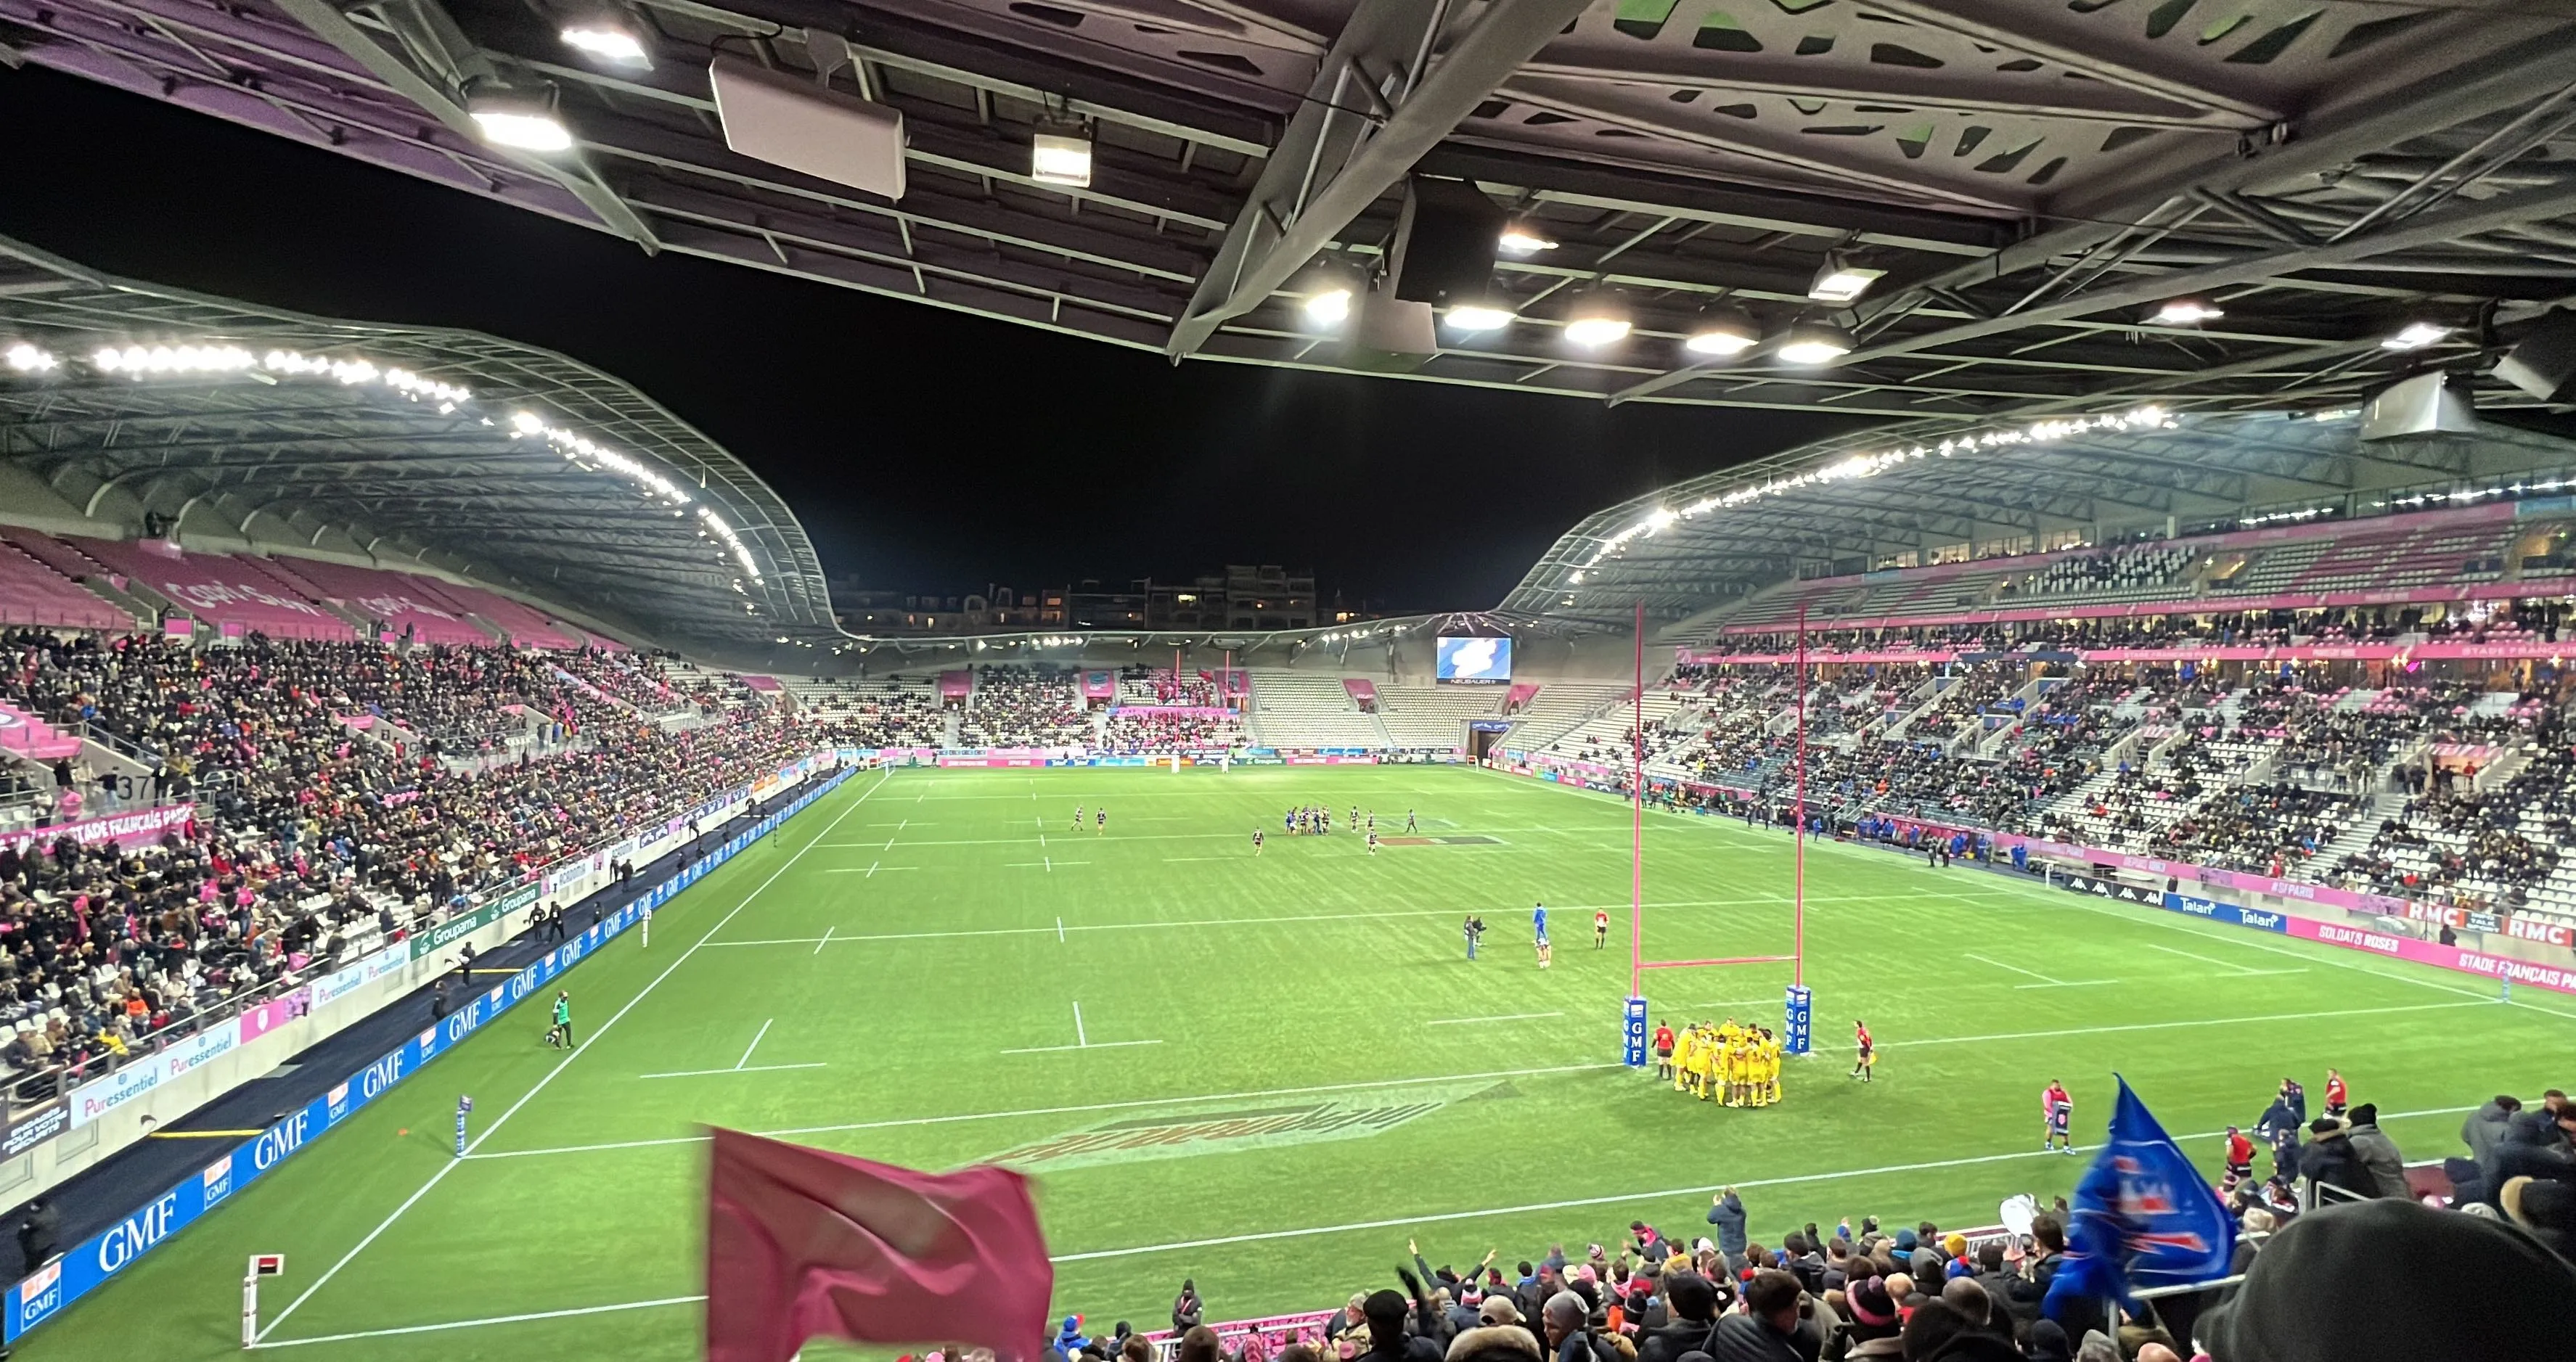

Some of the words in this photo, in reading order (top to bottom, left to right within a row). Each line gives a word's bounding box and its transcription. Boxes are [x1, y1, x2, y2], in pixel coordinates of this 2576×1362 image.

[116, 775, 151, 800] 37
[502, 887, 536, 913] Groupama
[2180, 897, 2212, 916] Talan
[2408, 902, 2459, 925] RMC
[433, 915, 477, 945] Groupama
[2239, 908, 2275, 928] Talan
[2508, 918, 2565, 945] RMC
[562, 937, 582, 967] GMF
[2318, 924, 2363, 945] SOLDATS
[2363, 933, 2399, 953] ROSES
[2459, 953, 2497, 973] STADE
[319, 971, 361, 1003] Puressentiel
[512, 966, 537, 1000] GMF
[449, 1001, 482, 1042] GMF
[1796, 1011, 1807, 1050] GMF
[171, 1032, 232, 1075] Puressentiel
[1631, 1022, 1643, 1062] GMF
[363, 1049, 404, 1099] GMF
[84, 1067, 158, 1118] Puressentiel
[330, 1102, 347, 1120] GMF
[255, 1109, 309, 1170] GMF
[206, 1178, 229, 1202] GMF
[99, 1192, 176, 1272] GMF
[25, 1288, 58, 1321] GMF
